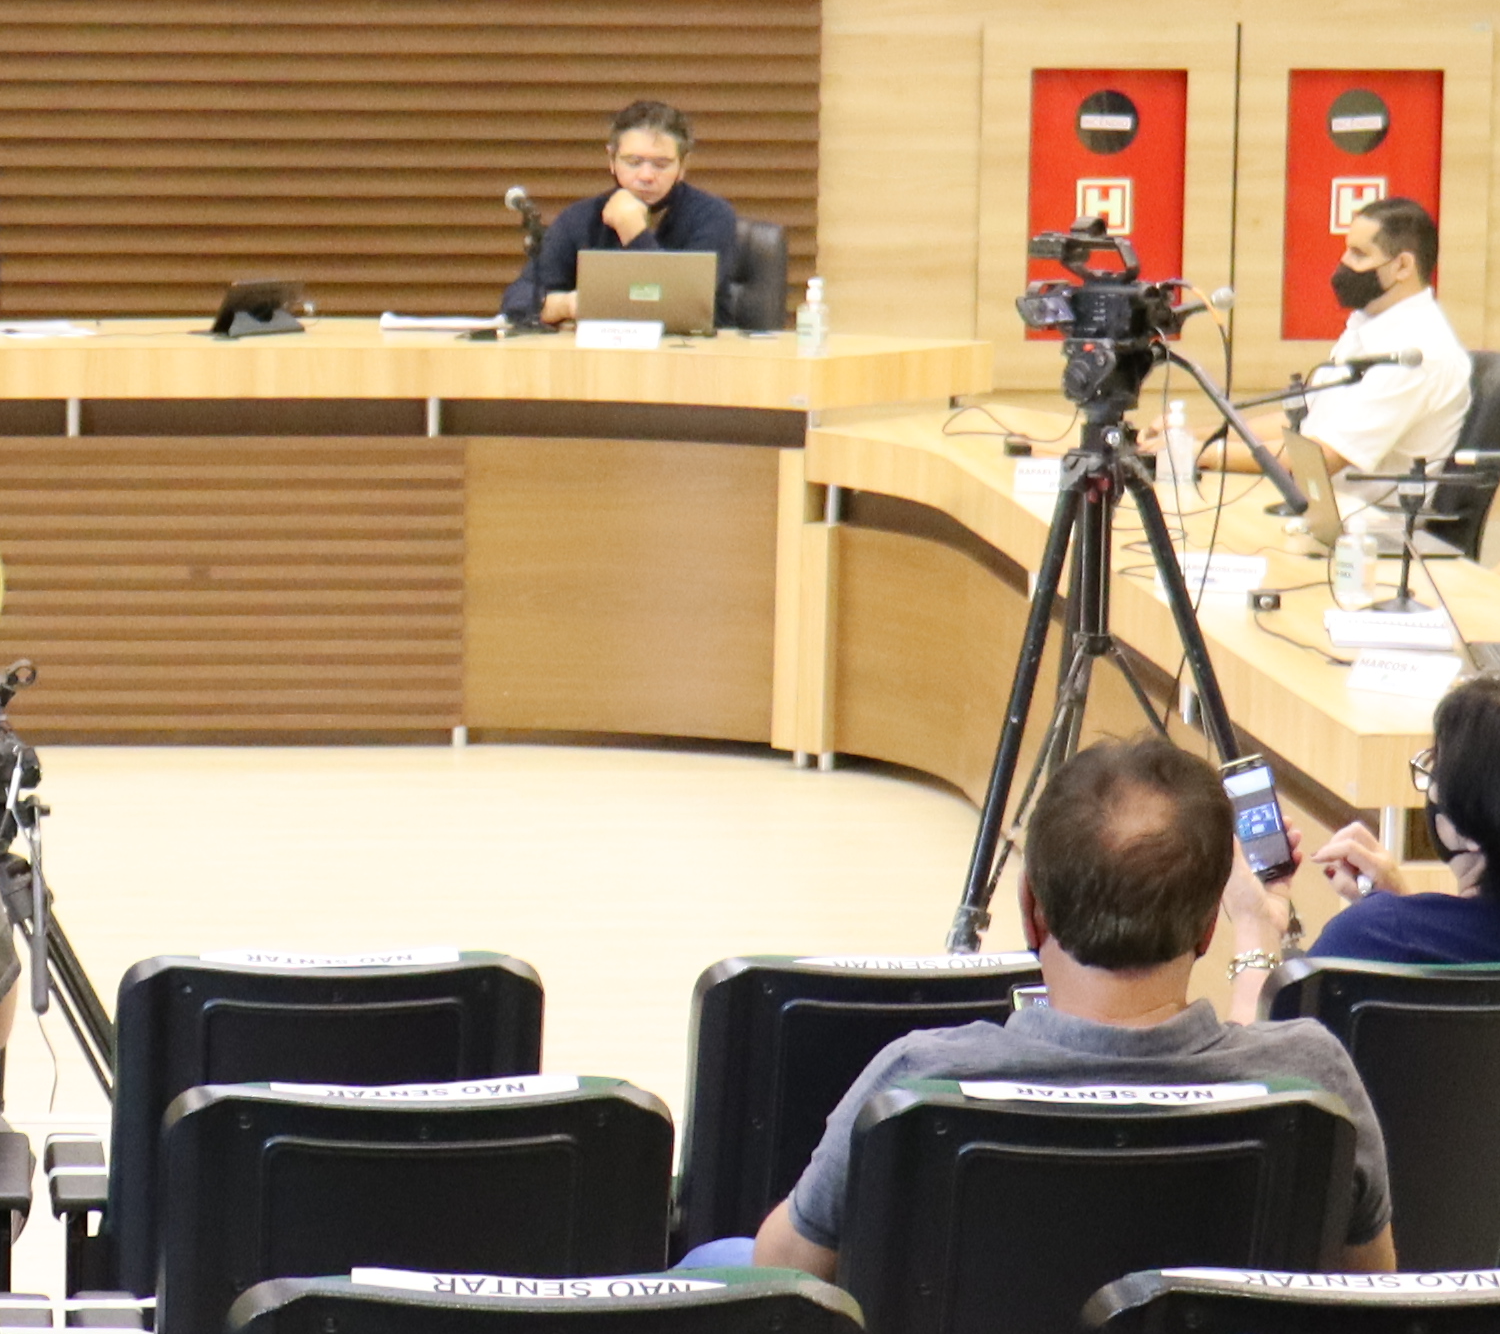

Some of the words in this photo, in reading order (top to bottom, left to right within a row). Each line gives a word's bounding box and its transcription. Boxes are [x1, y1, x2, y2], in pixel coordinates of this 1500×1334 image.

[1085, 187, 1123, 226] H
[1359, 658, 1408, 672] MARCOS
[248, 954, 348, 965] SENTAR
[326, 1088, 449, 1098] SENTAR
[1016, 1087, 1136, 1099] SENTAR
[434, 1276, 591, 1297] SENTAR
[1243, 1273, 1399, 1288] SENTAR
